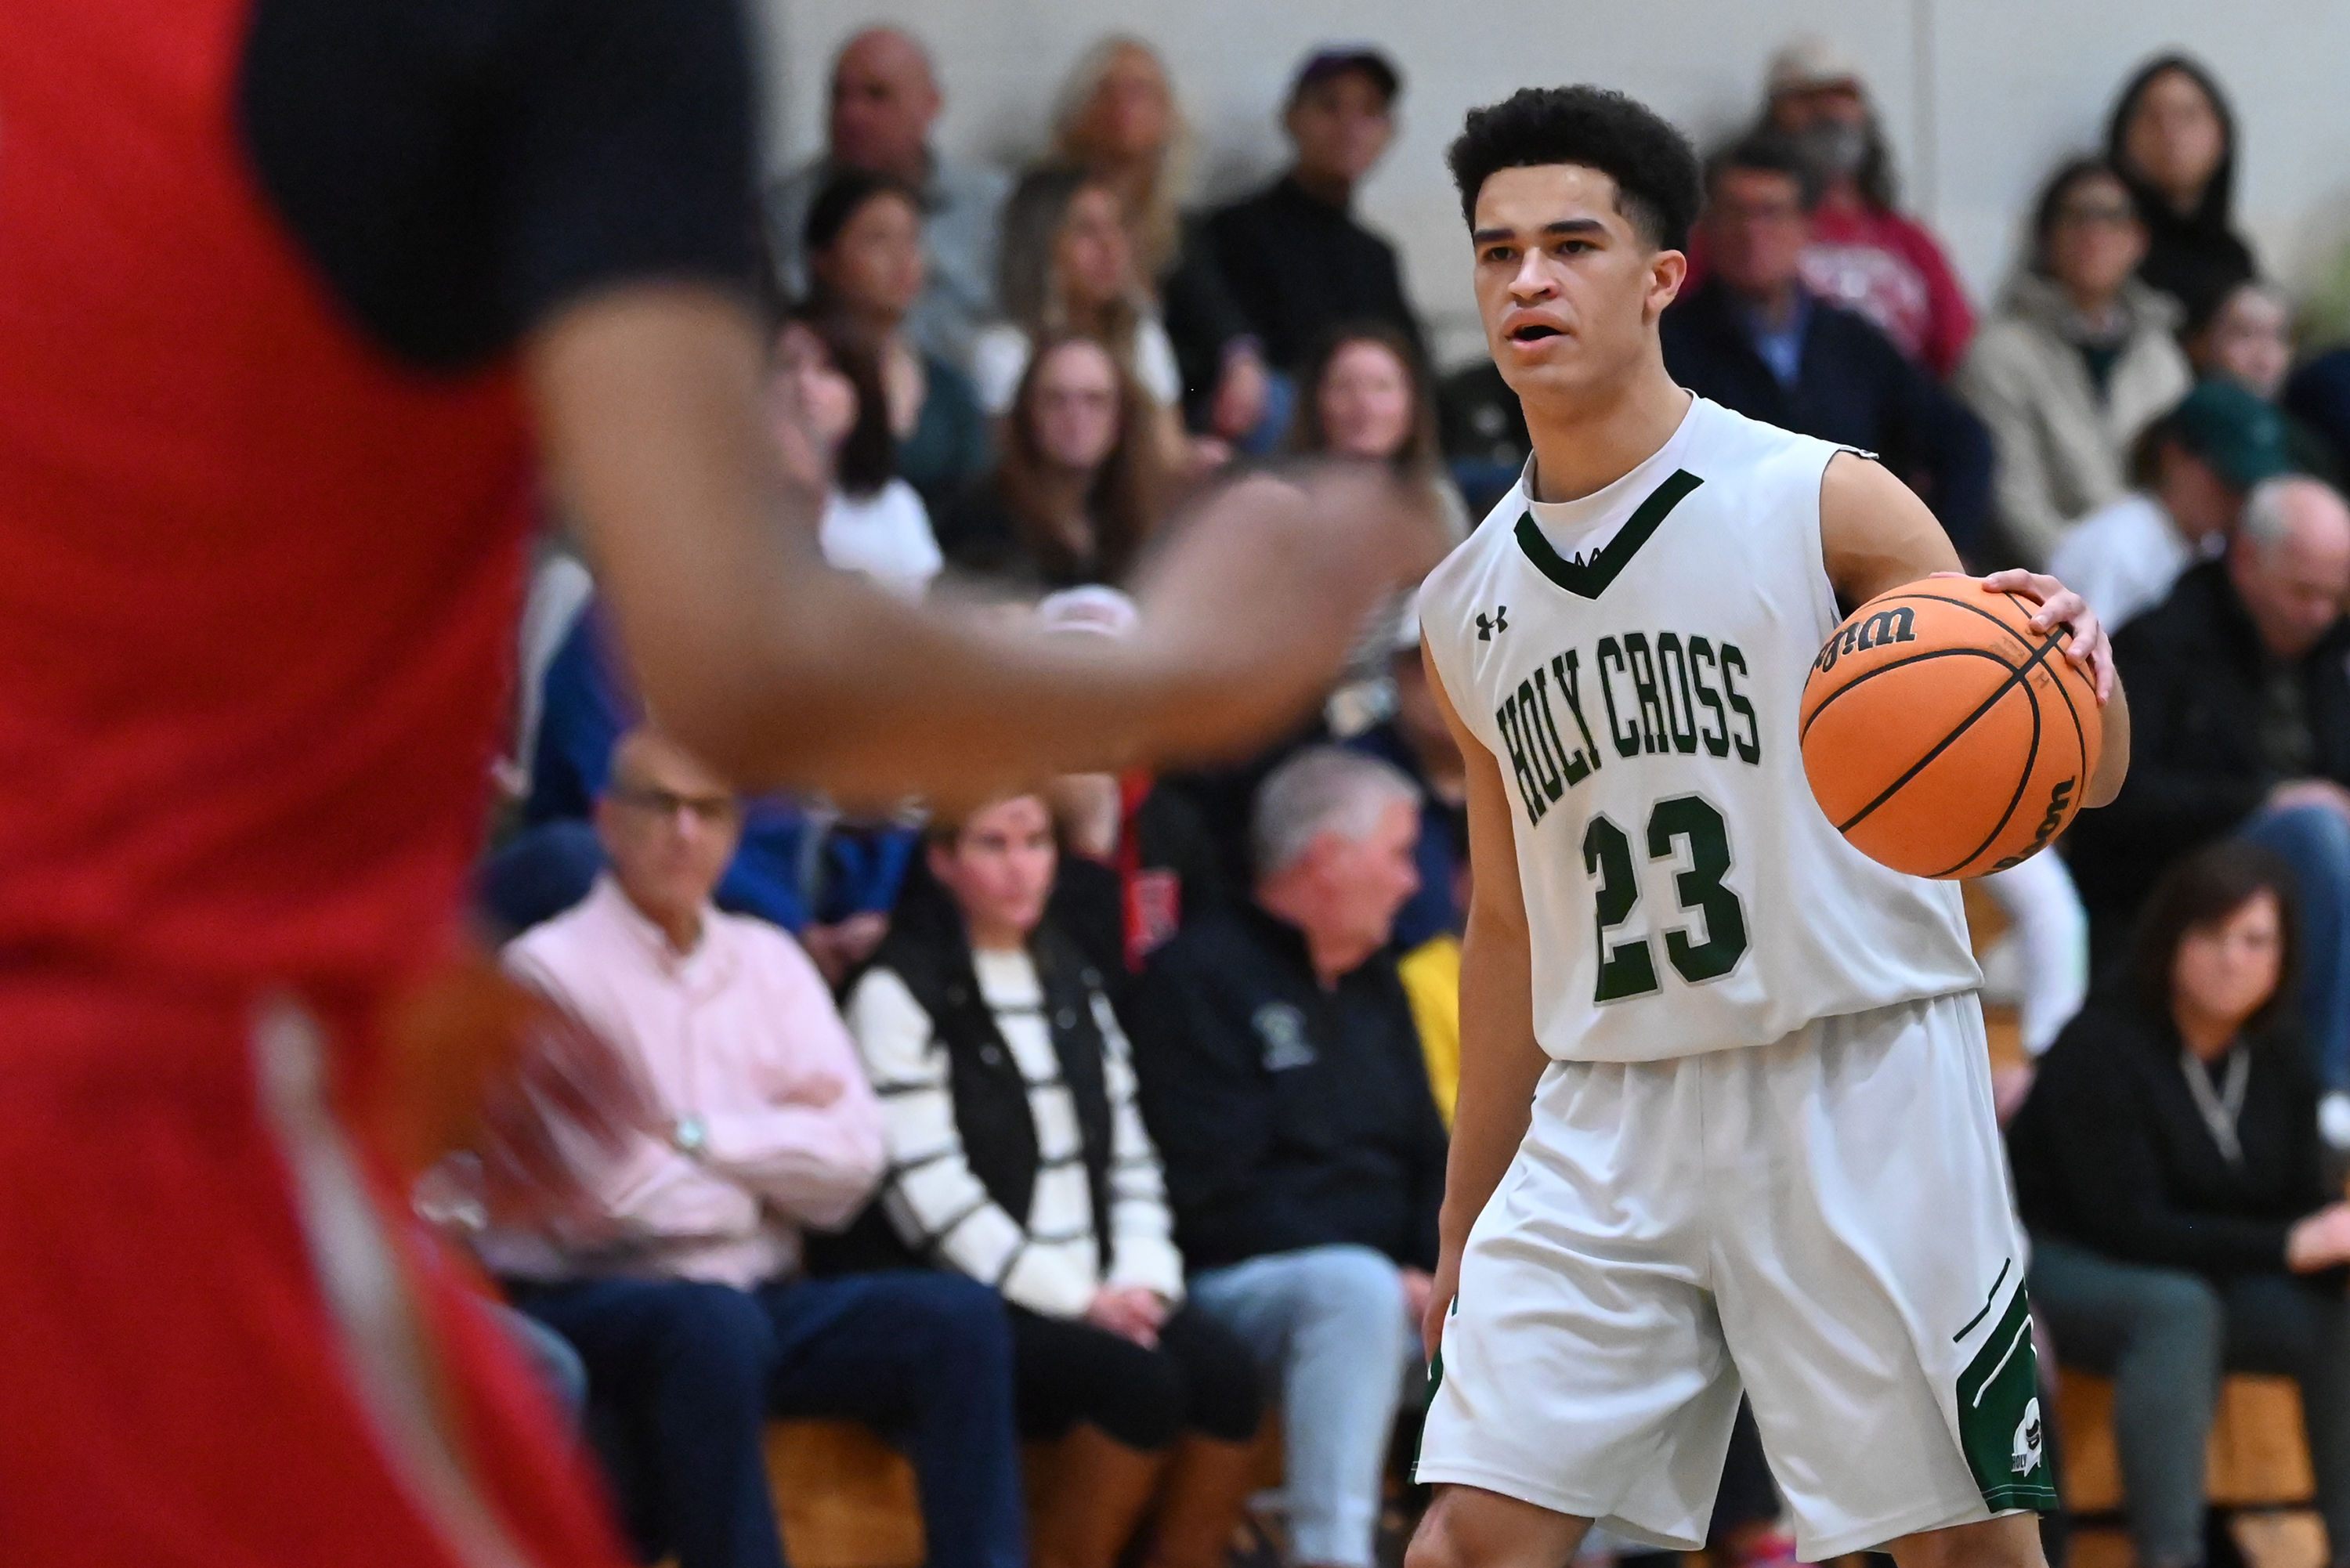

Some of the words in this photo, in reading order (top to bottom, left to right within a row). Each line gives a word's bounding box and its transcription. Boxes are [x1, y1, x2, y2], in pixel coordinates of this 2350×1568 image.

[1495, 648, 1603, 829] HOLY
[1596, 630, 1761, 768] CROSS
[1580, 790, 1753, 1008] 23
